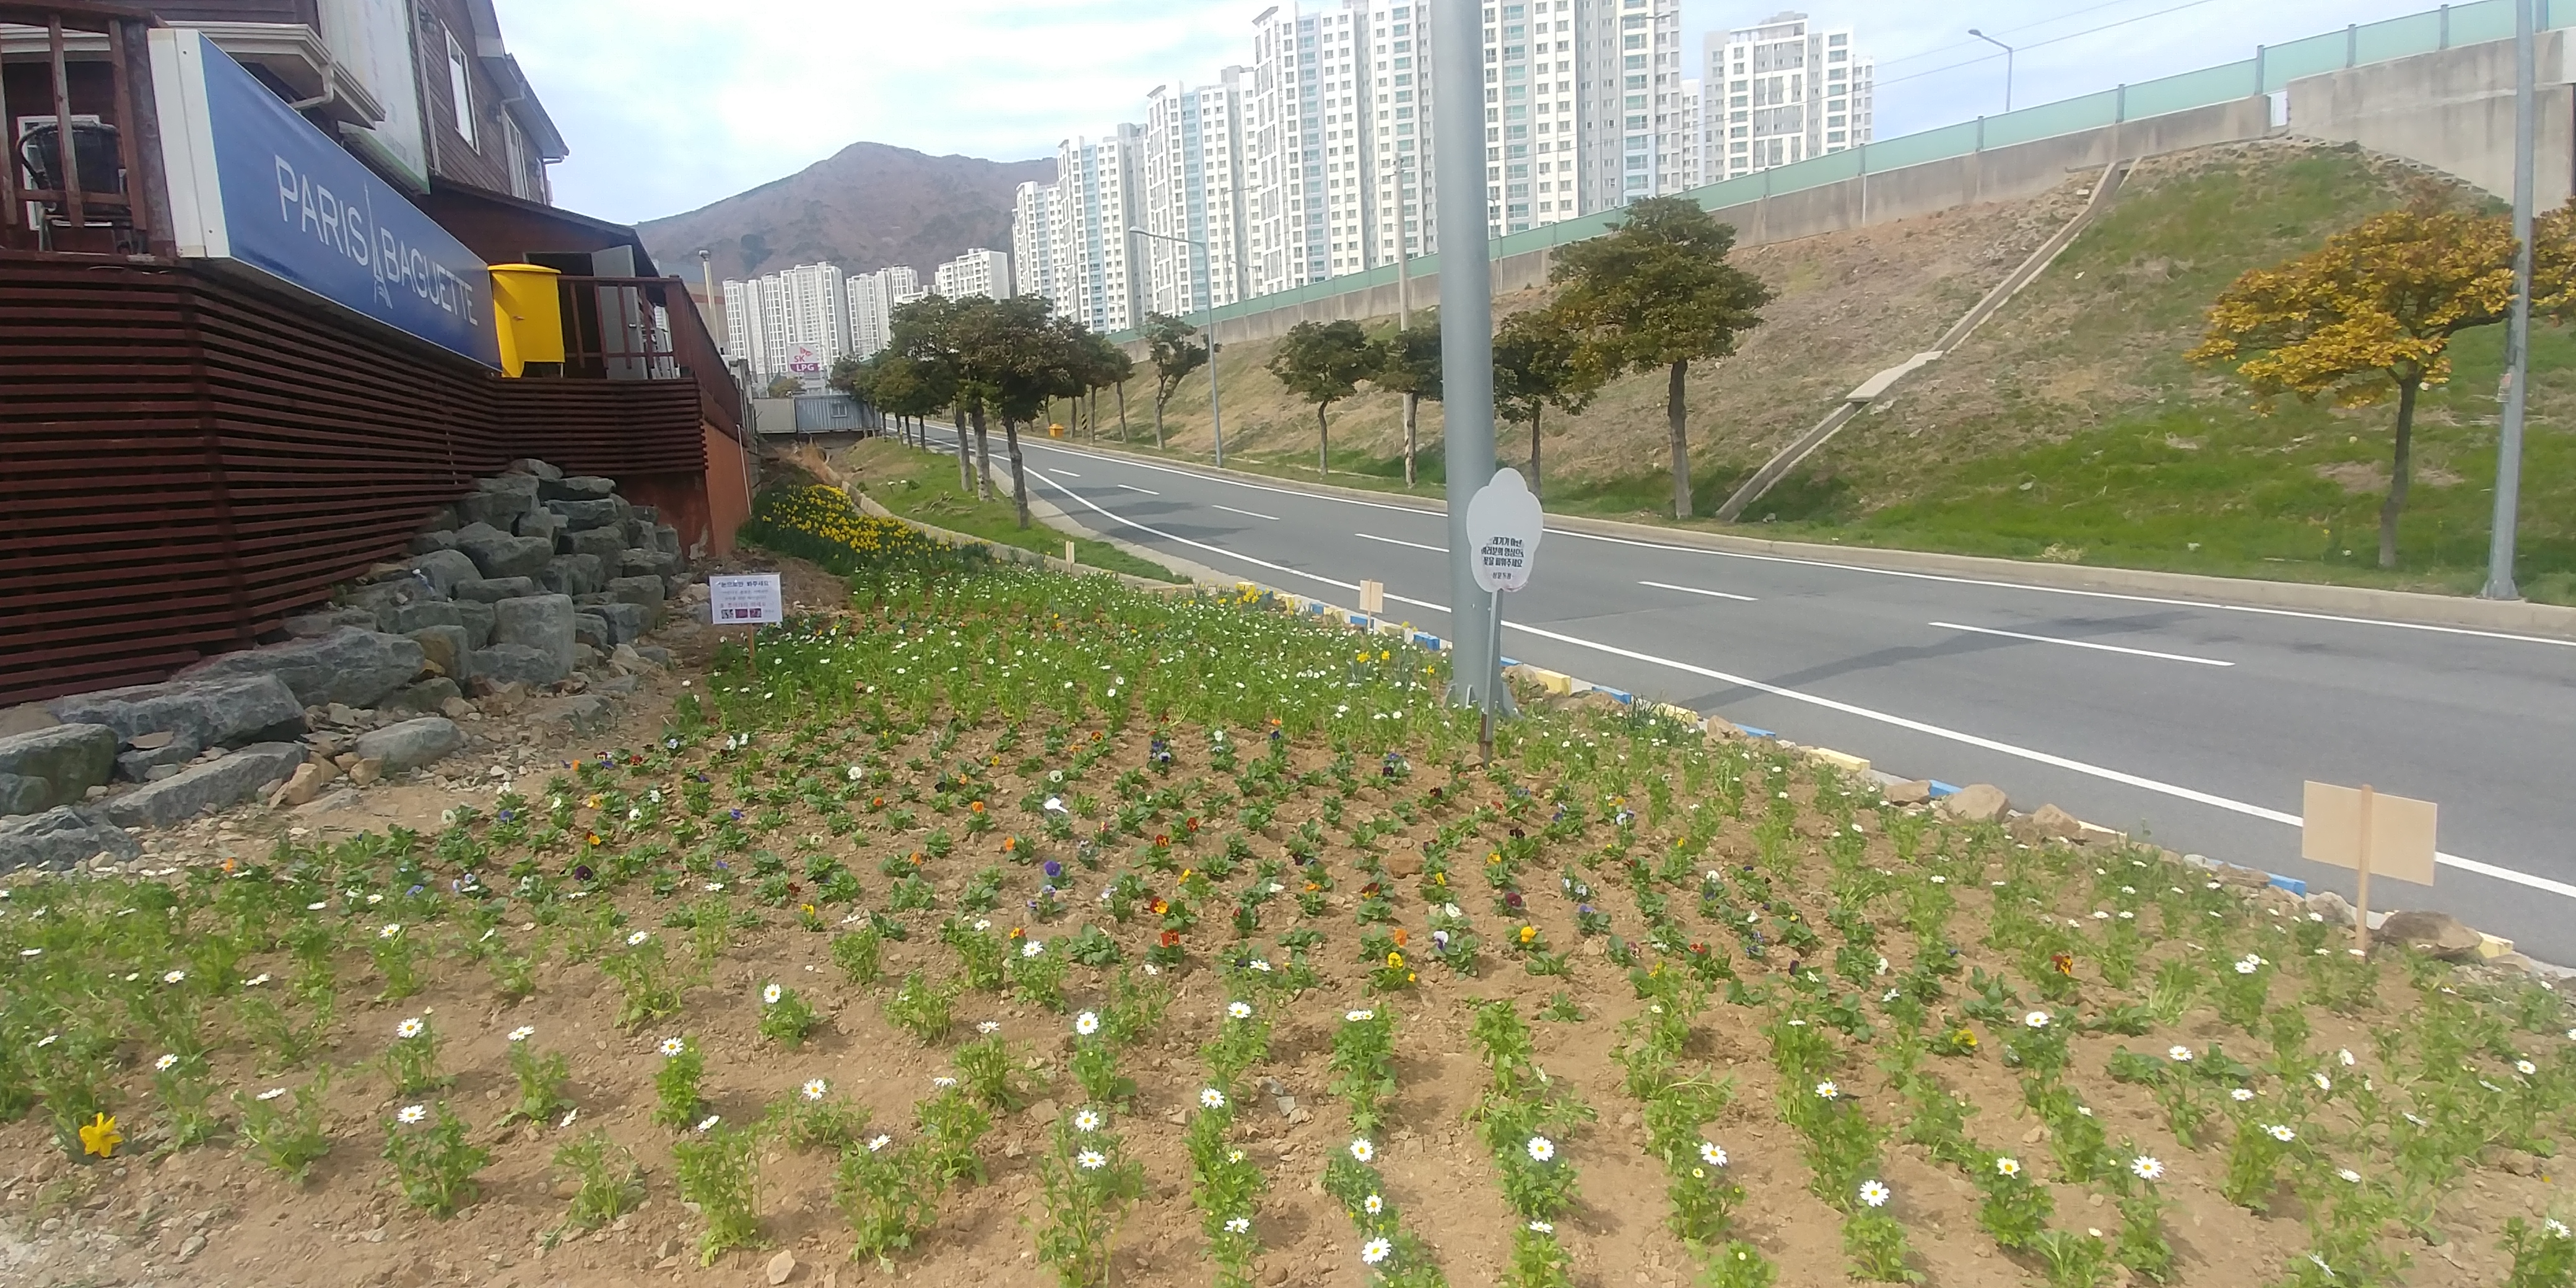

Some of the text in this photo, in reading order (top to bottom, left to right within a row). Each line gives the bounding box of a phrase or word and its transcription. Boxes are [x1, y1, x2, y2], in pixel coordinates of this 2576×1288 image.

[273, 154, 479, 327] PARIS BAGUETTE
[796, 363, 815, 372] LPG
[1487, 536, 1510, 546] 레기가
[1481, 546, 1503, 556] 여러분의
[1495, 557, 1523, 567] 피워주세요
